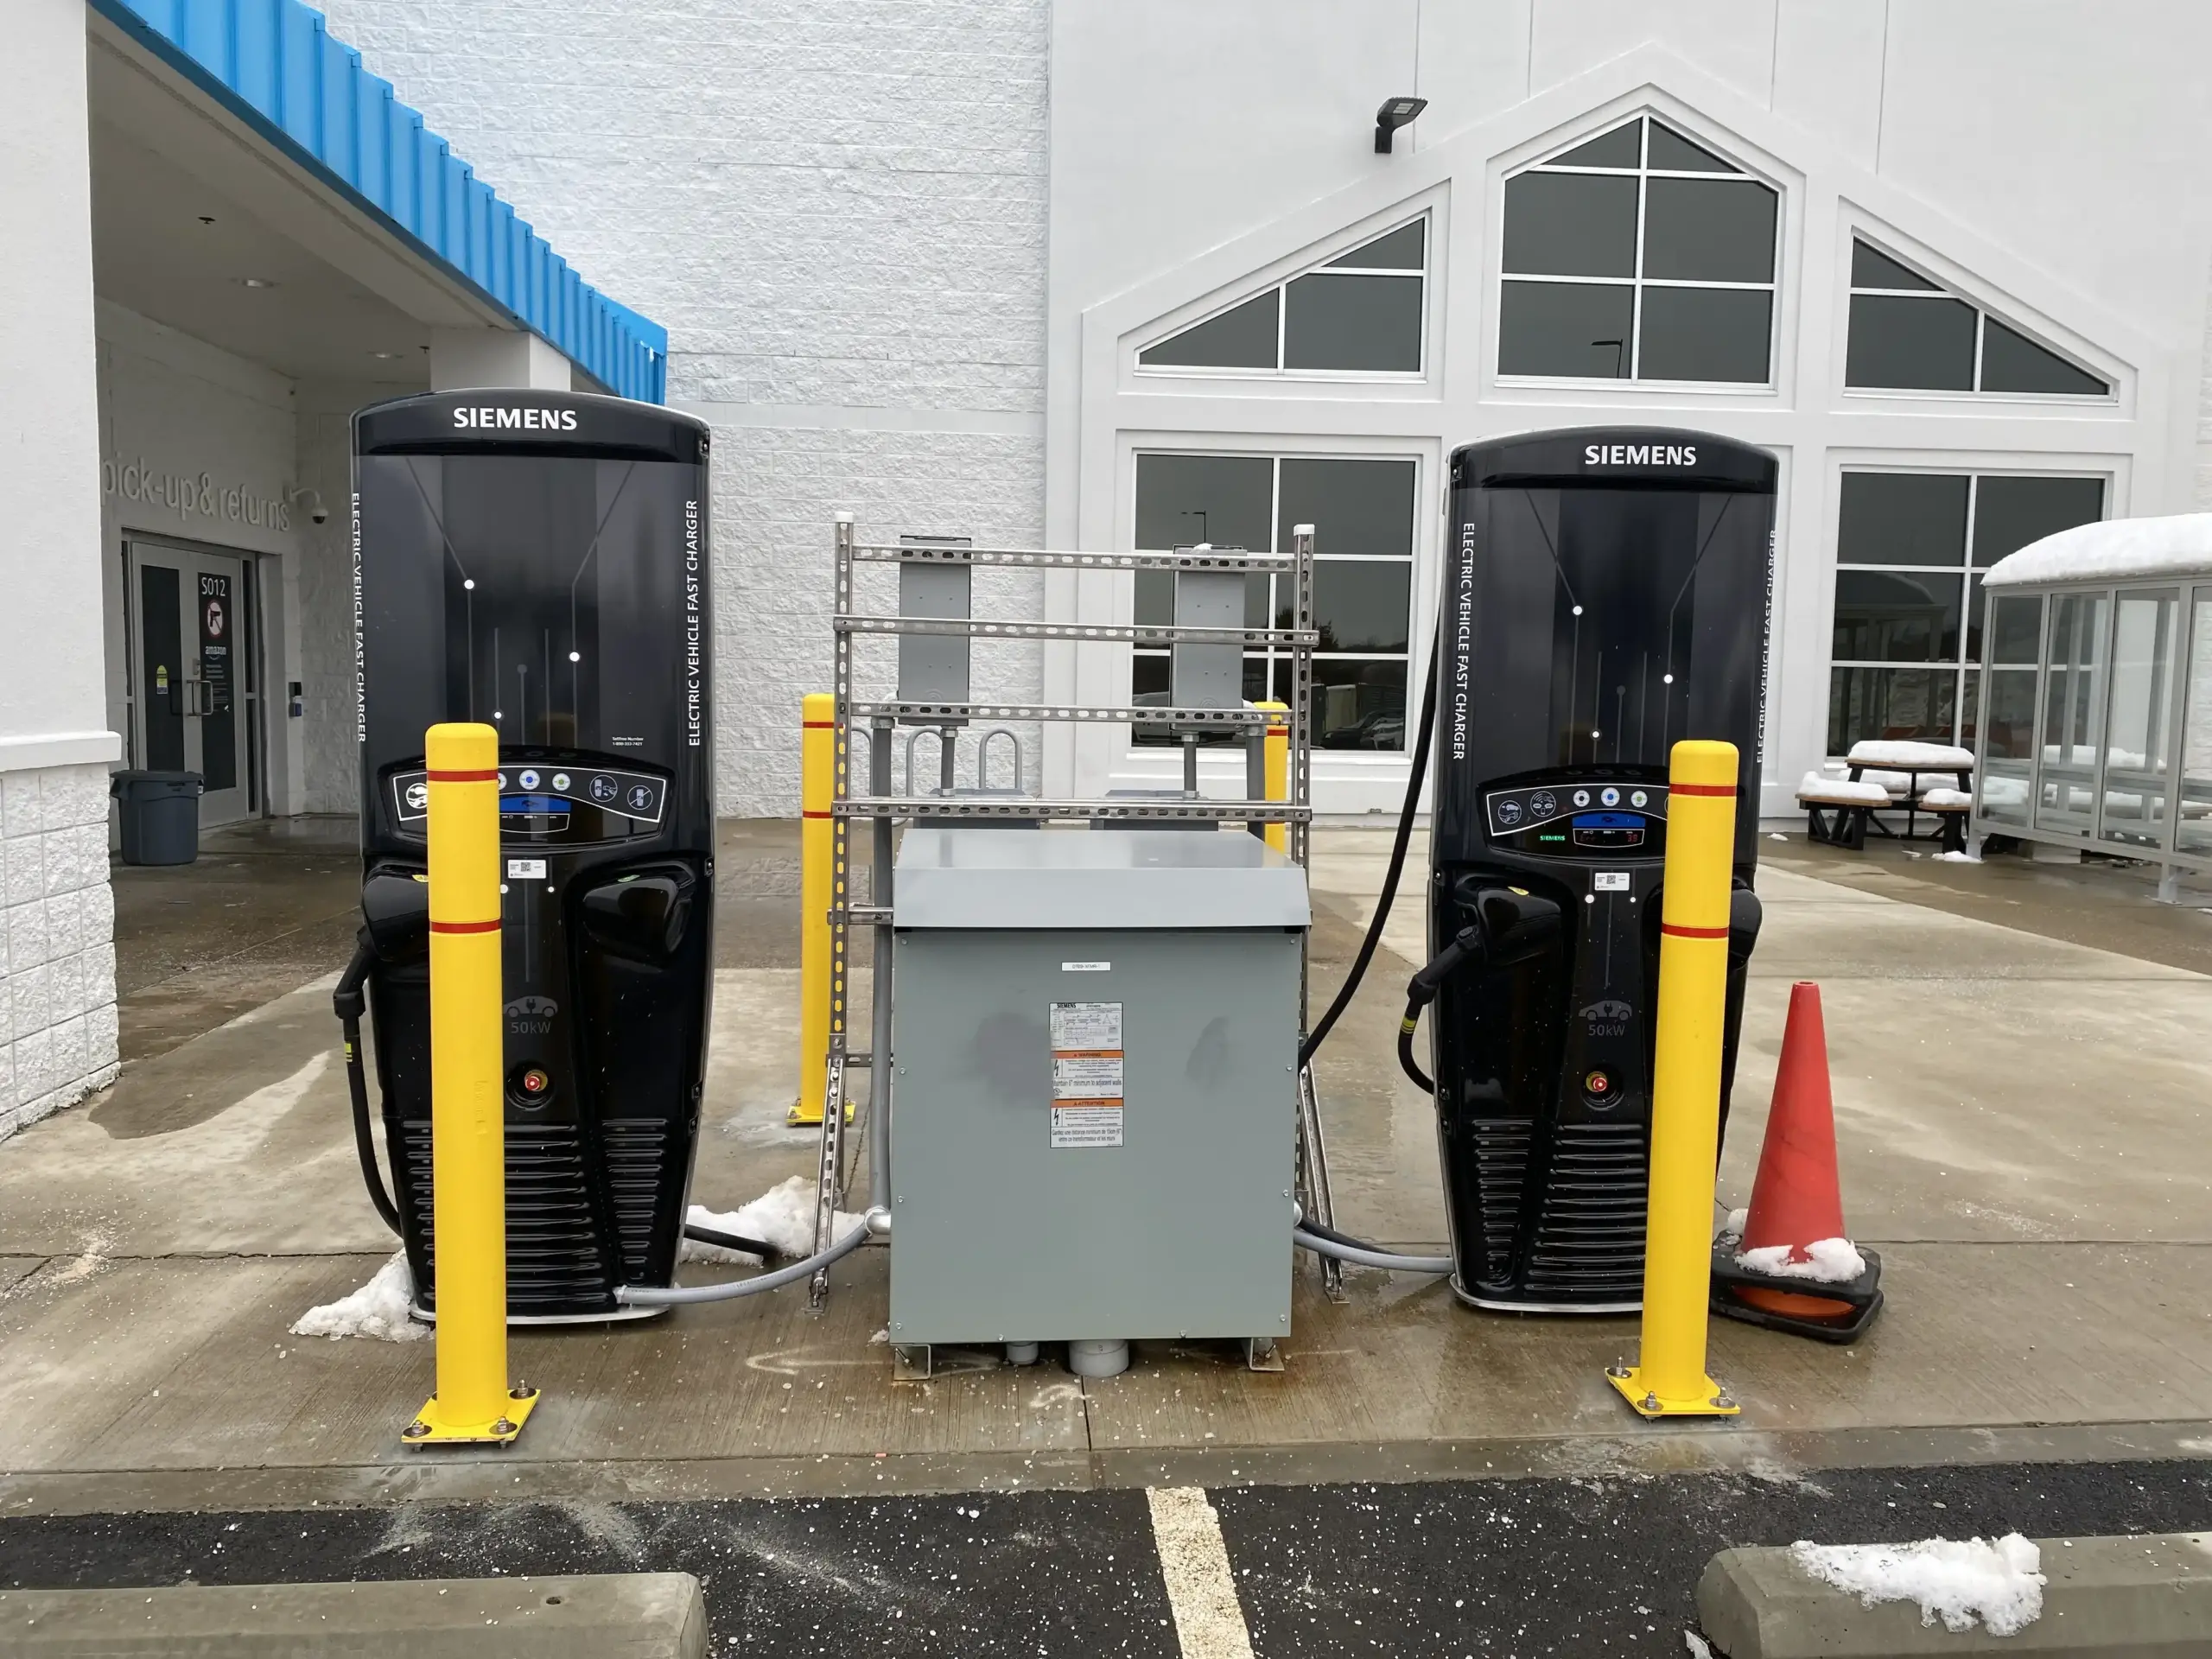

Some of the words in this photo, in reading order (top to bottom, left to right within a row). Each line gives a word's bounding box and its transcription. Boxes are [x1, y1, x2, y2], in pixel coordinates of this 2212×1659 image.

[454, 407, 577, 430] SIEMENS
[1585, 445, 1697, 466] SIEMENS
[101, 450, 195, 521] pick-up
[199, 472, 216, 516] &
[219, 484, 290, 531] returns
[352, 493, 361, 562] ELECTRIC
[686, 500, 697, 571] CHARGER
[1460, 523, 1475, 589] ELECTRIC
[687, 574, 698, 611] FAST
[1766, 529, 1777, 597] CHARGER
[353, 565, 363, 627] VEHICLE
[1458, 592, 1471, 652] VEHICLE
[1764, 600, 1772, 634] FAST
[205, 645, 226, 656] amazon
[355, 632, 364, 668] FAST
[688, 614, 699, 677] VEHICLE
[1456, 655, 1469, 690] FAST
[357, 671, 365, 742] CHARGER
[689, 679, 700, 746] ELECTRIC
[1452, 693, 1467, 760] CHARGER
[511, 1021, 551, 1033] 50kW
[1588, 1025, 1625, 1036] 50kW
